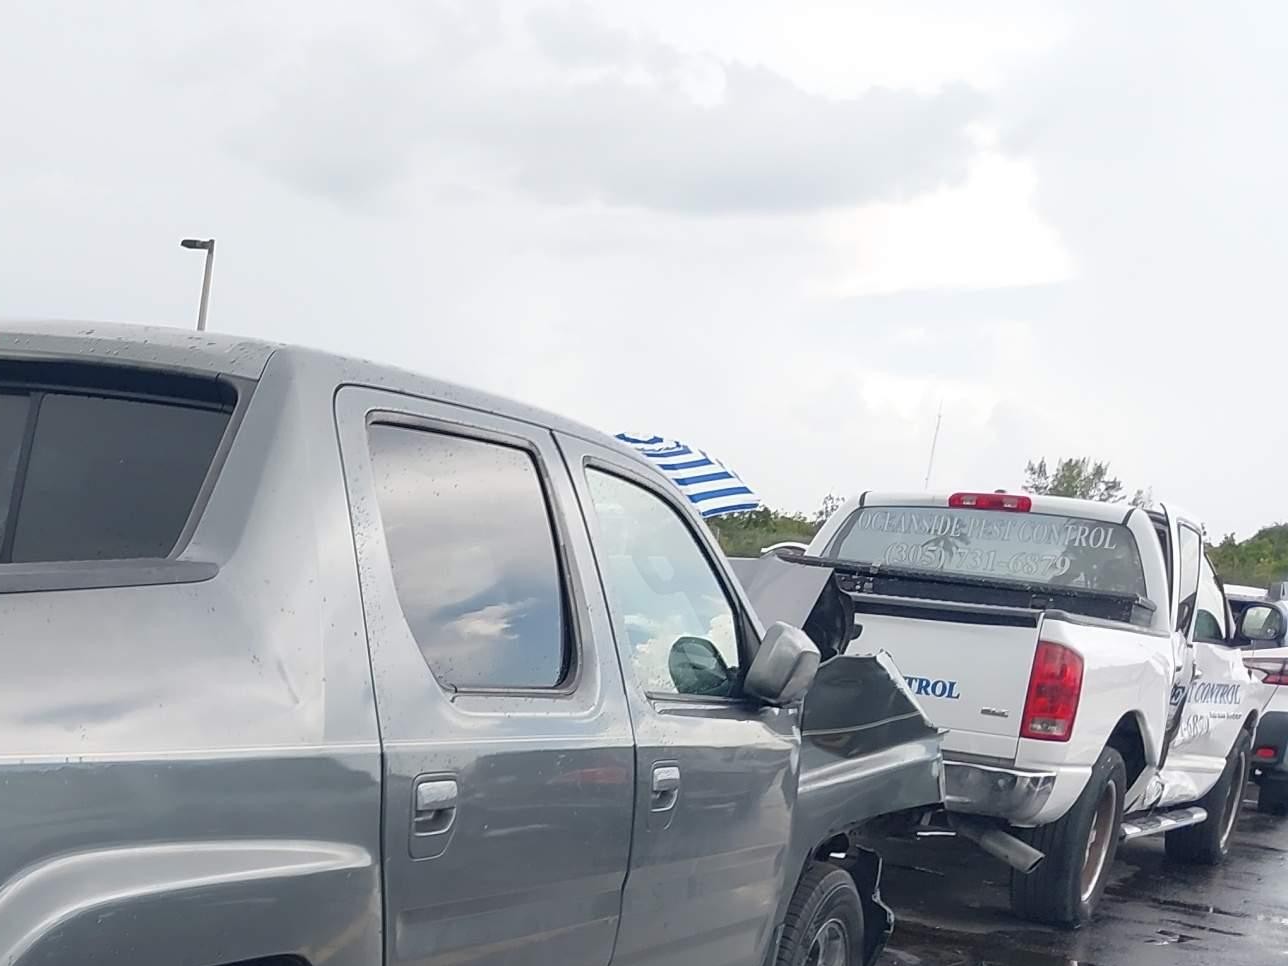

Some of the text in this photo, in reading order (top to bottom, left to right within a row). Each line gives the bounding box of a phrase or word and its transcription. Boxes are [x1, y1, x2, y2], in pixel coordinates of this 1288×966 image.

[857, 510, 1118, 550] OCEANSIDE PEST CONTROL
[883, 542, 1071, 577] (305) 731-6879
[1195, 682, 1241, 705] CONTROL
